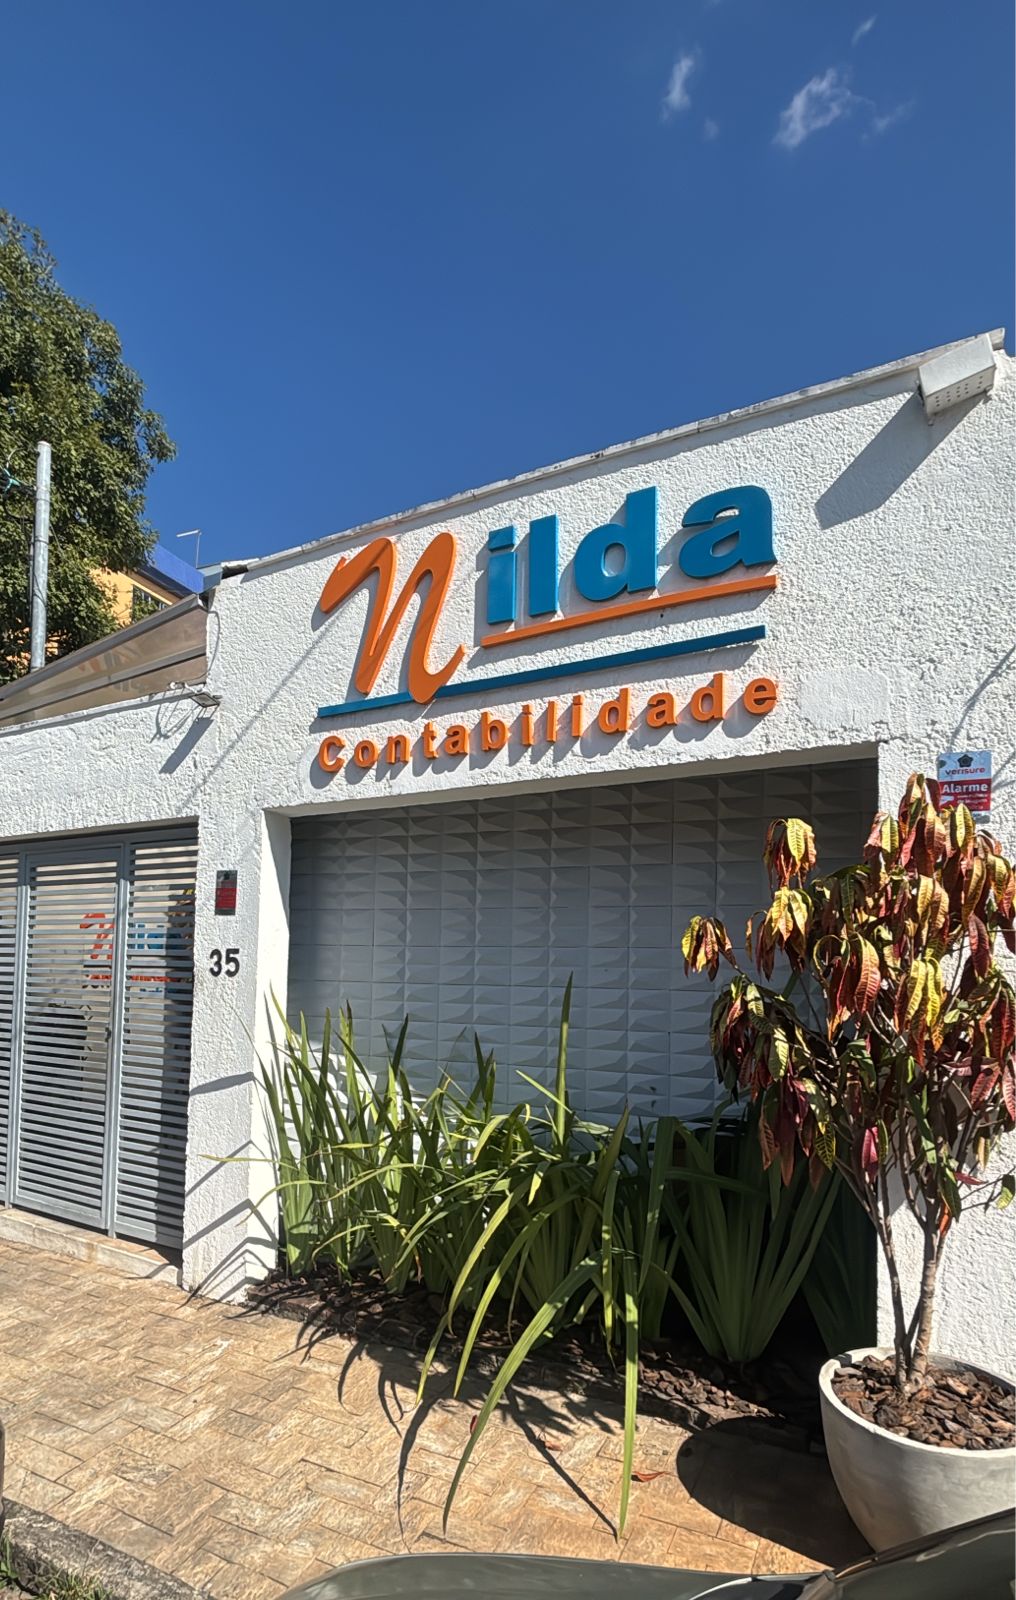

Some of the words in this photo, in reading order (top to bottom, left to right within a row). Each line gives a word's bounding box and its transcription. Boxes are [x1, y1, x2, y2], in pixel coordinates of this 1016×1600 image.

[318, 673, 779, 773] Contabilidade
[942, 783, 989, 793] Alarme
[209, 948, 240, 977] 35
